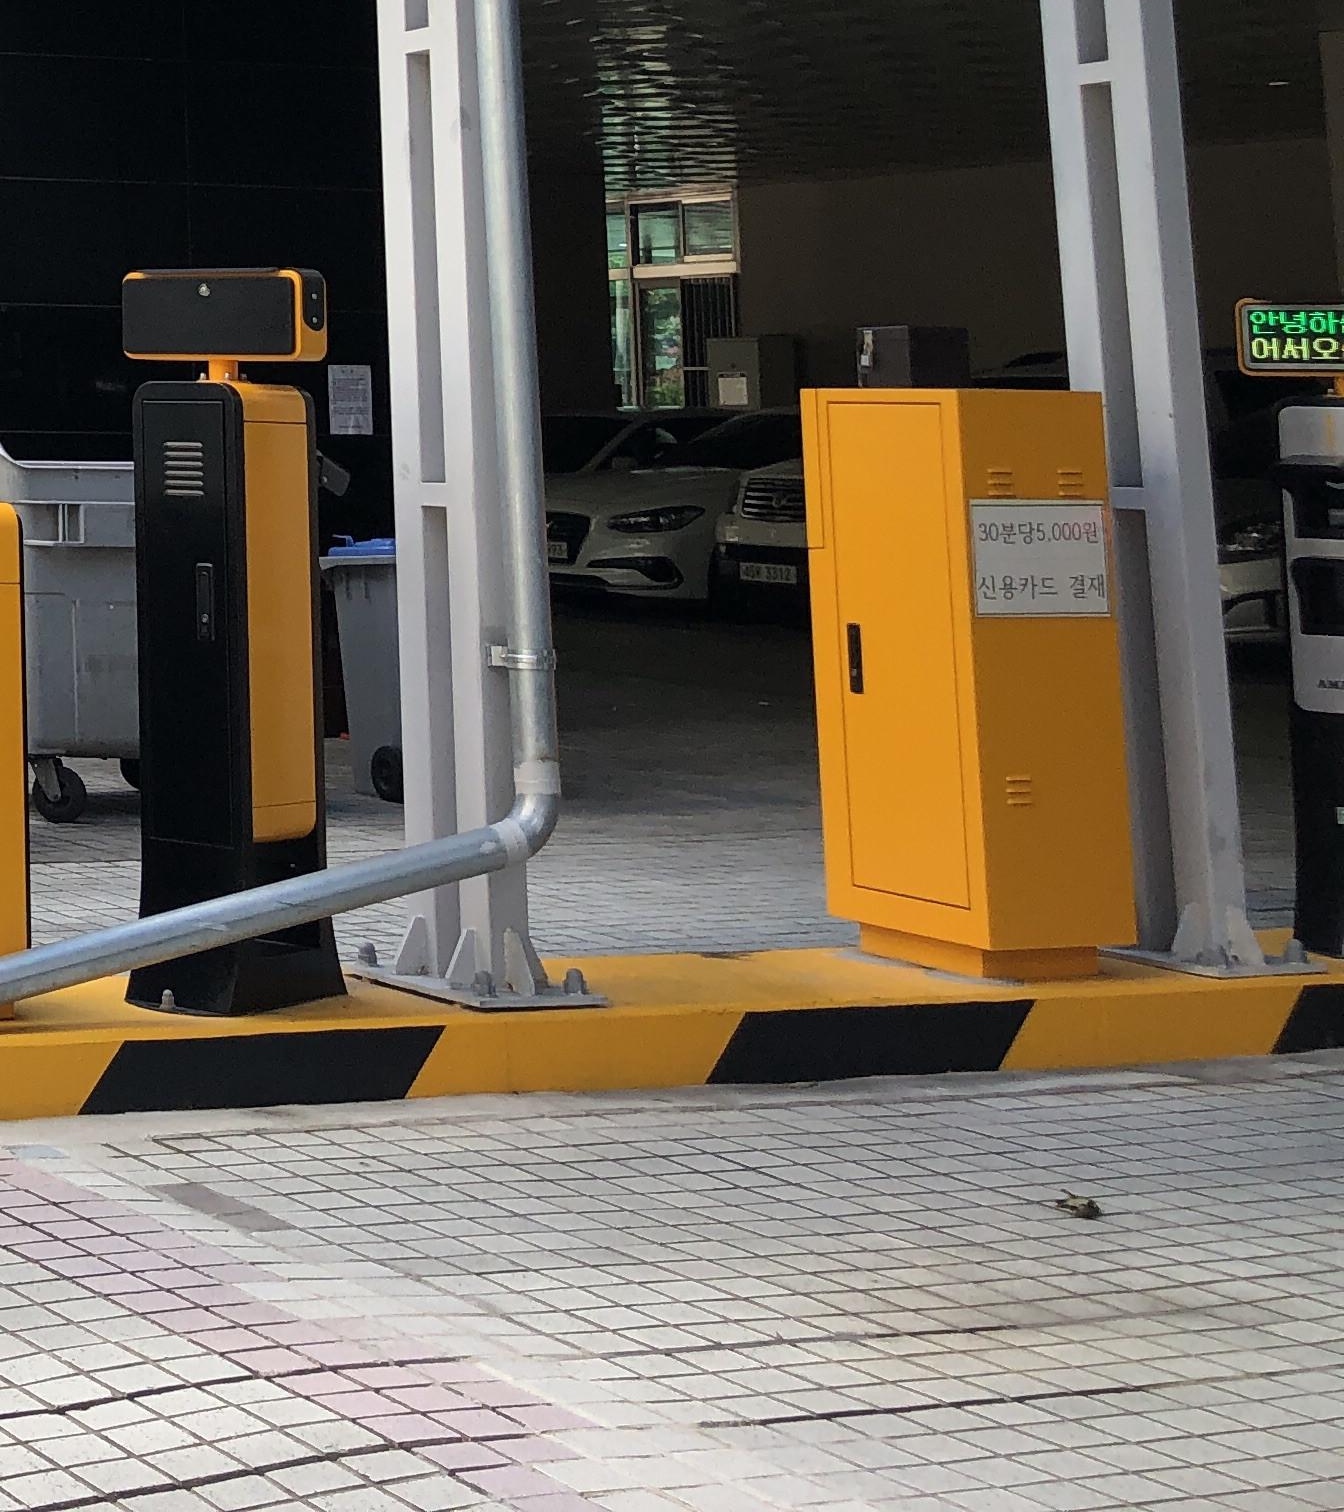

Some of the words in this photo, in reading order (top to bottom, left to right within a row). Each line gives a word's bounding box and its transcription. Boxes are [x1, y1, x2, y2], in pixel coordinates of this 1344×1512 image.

[1249, 311, 1344, 334] 안녕하
[1251, 337, 1344, 361] 어서오
[978, 574, 1058, 601] 신용카드
[1069, 573, 1106, 599] 결재
